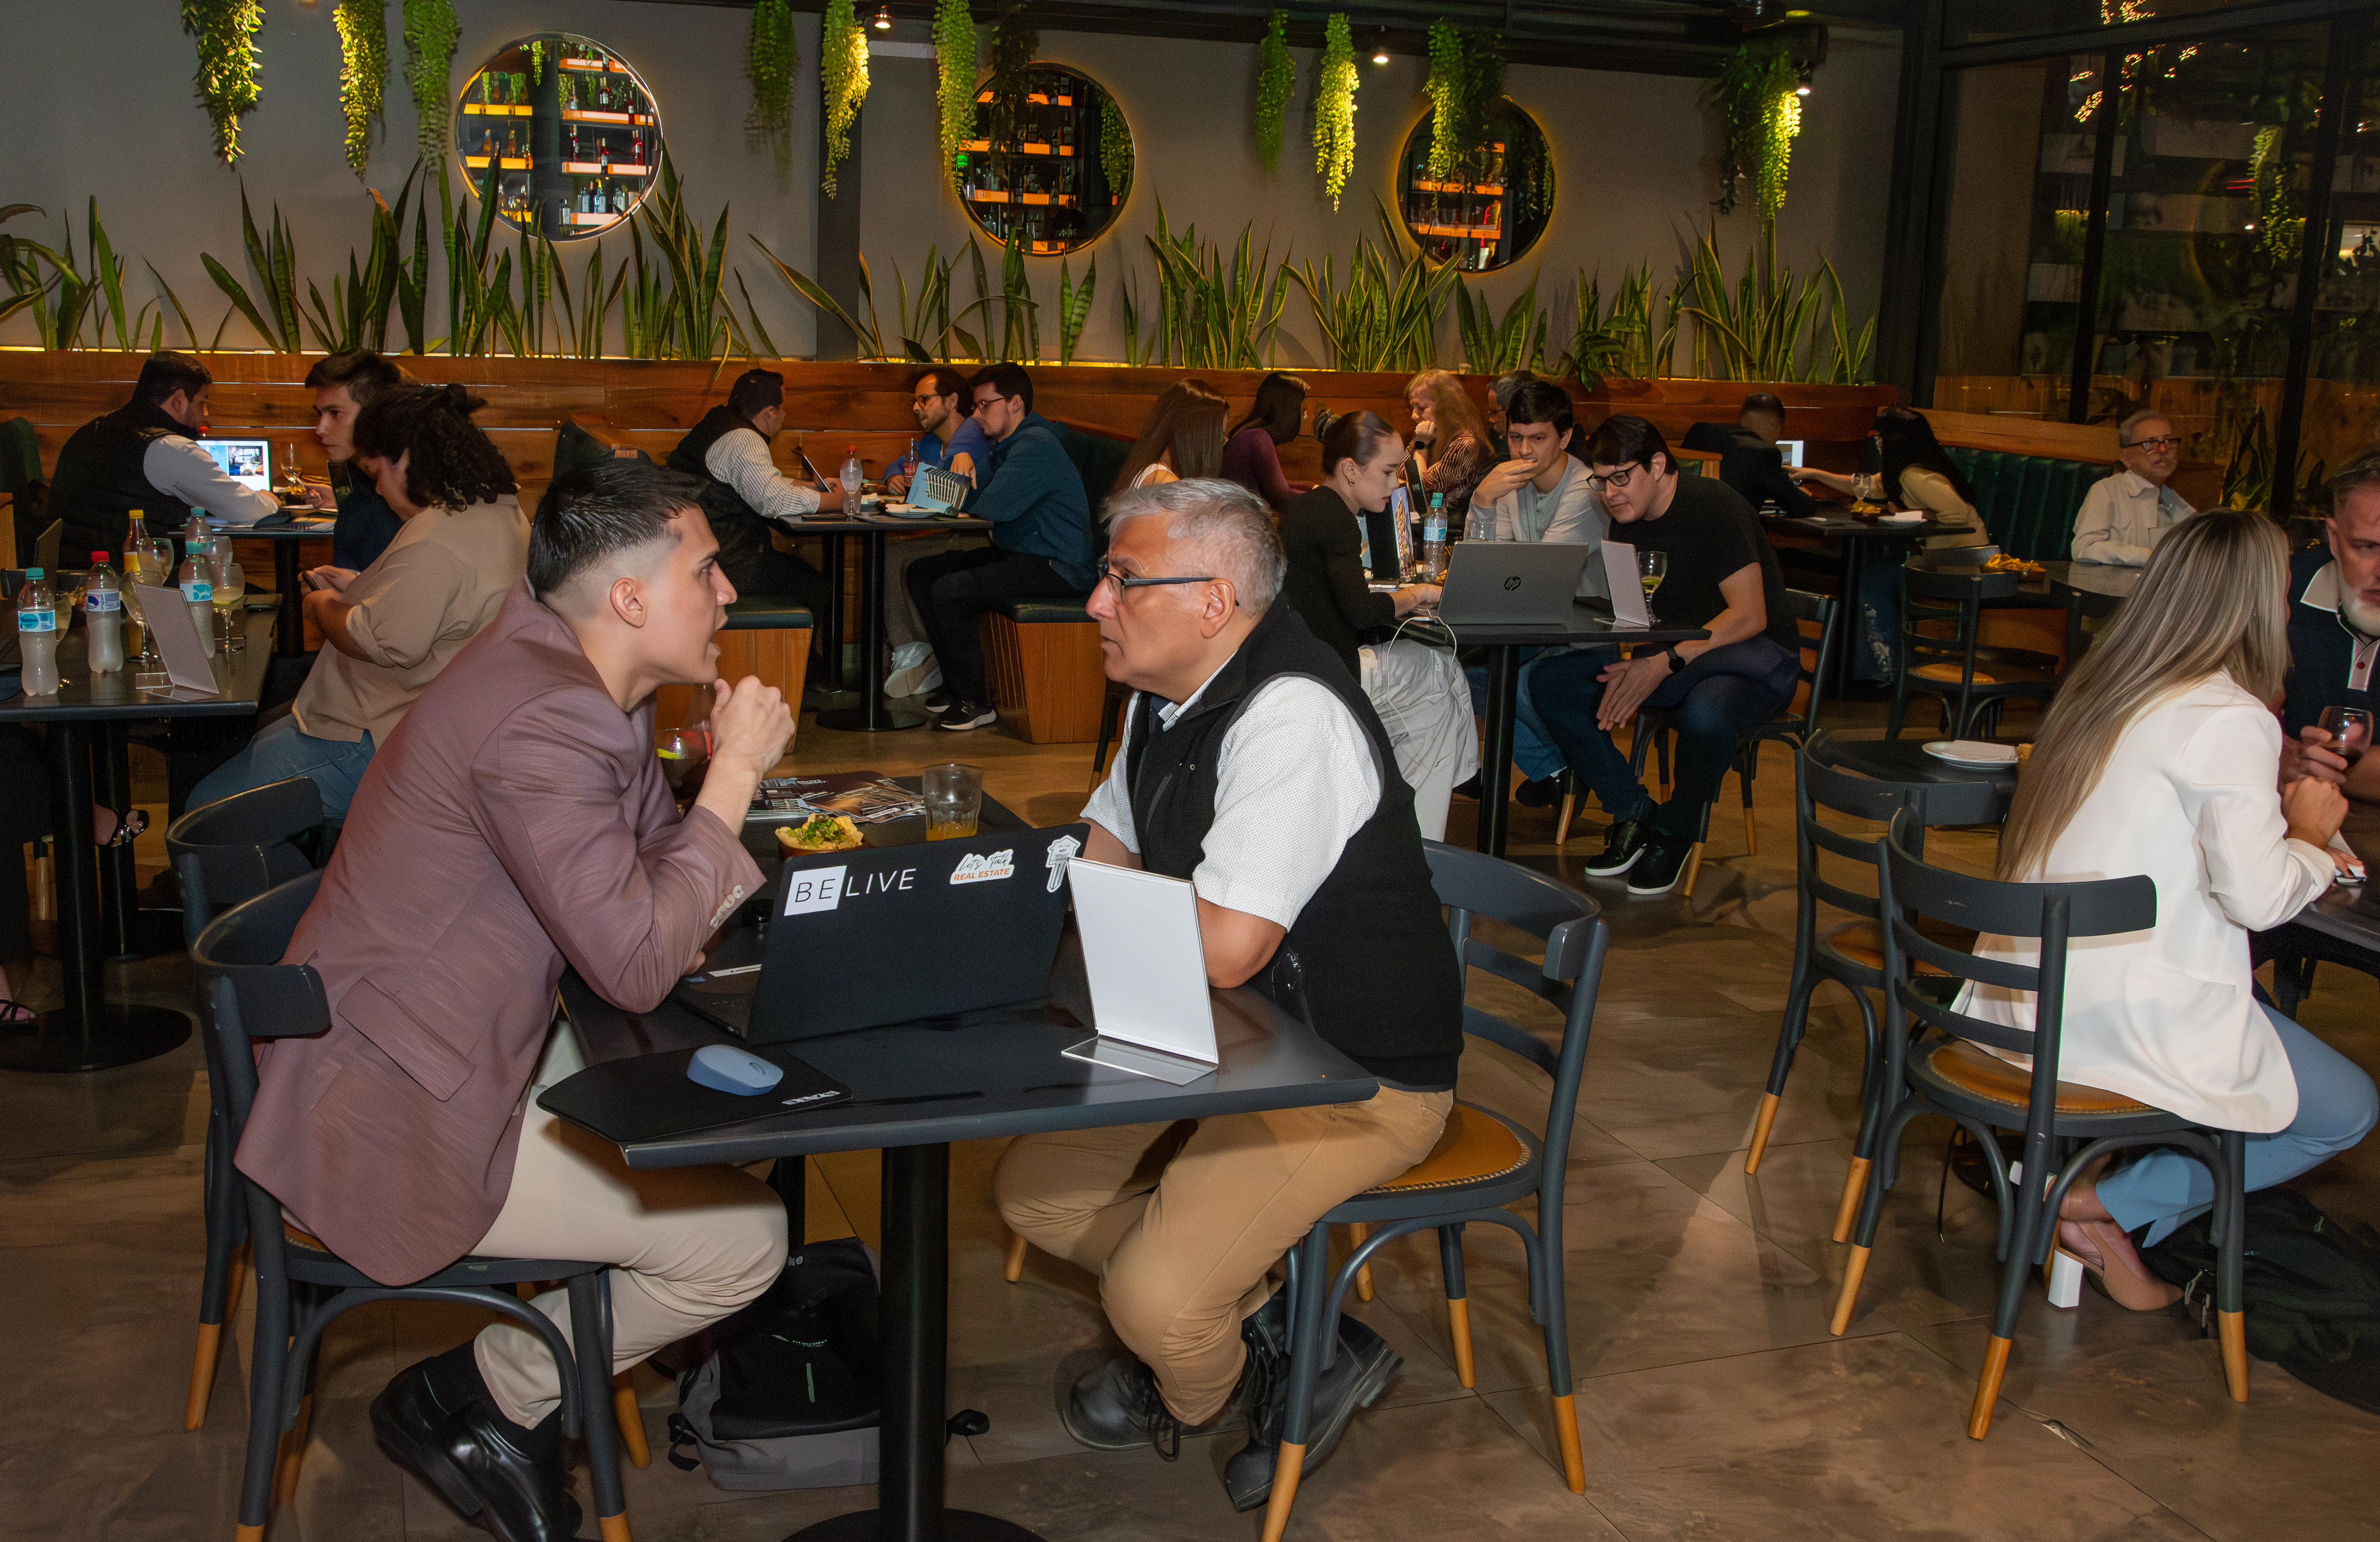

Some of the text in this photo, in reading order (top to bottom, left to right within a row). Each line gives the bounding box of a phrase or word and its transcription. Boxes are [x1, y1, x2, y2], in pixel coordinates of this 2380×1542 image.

[990, 852, 1009, 869] Talk
[953, 868, 1010, 881] REAL ESTATE
